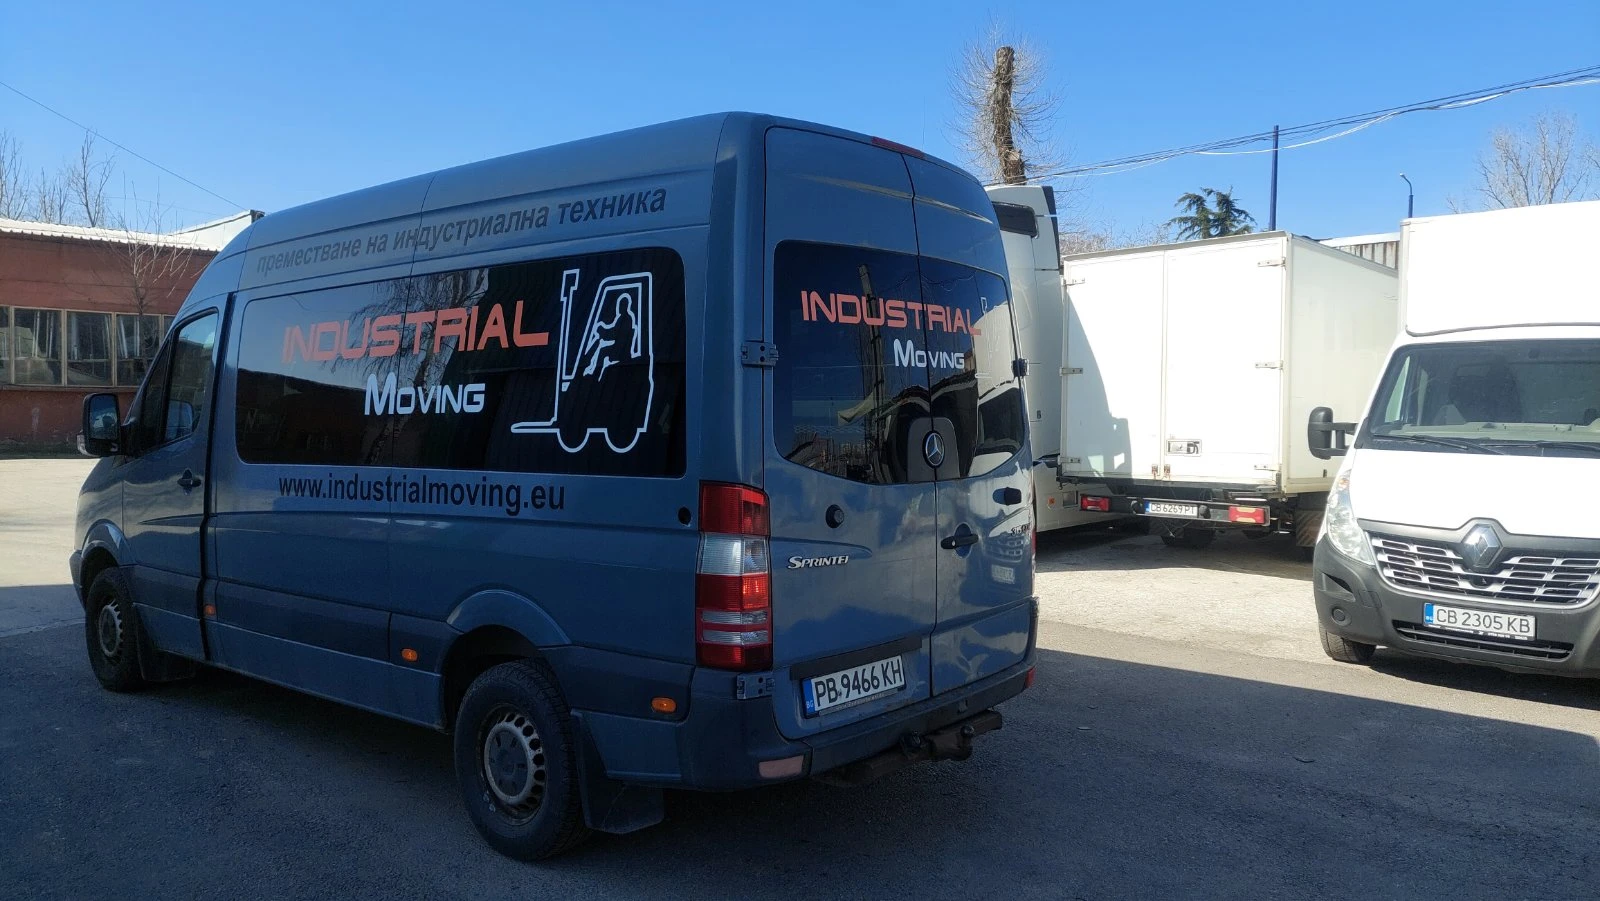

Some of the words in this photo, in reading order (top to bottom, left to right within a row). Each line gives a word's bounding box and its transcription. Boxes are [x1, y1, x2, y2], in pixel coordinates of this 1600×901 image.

[257, 238, 362, 276] преместване
[366, 233, 389, 254] на
[393, 206, 550, 251] индустриална
[558, 188, 667, 224] техника
[282, 300, 549, 364] INDUSTRIAL
[801, 290, 982, 336] INDUSTRIAL
[278, 473, 565, 516] www.industrialmoving.eu
[1436, 608, 1457, 624] CB
[1461, 612, 1503, 630] 2305
[1507, 616, 1530, 633] KB
[840, 665, 880, 698] 9466
[881, 658, 903, 687] KH
